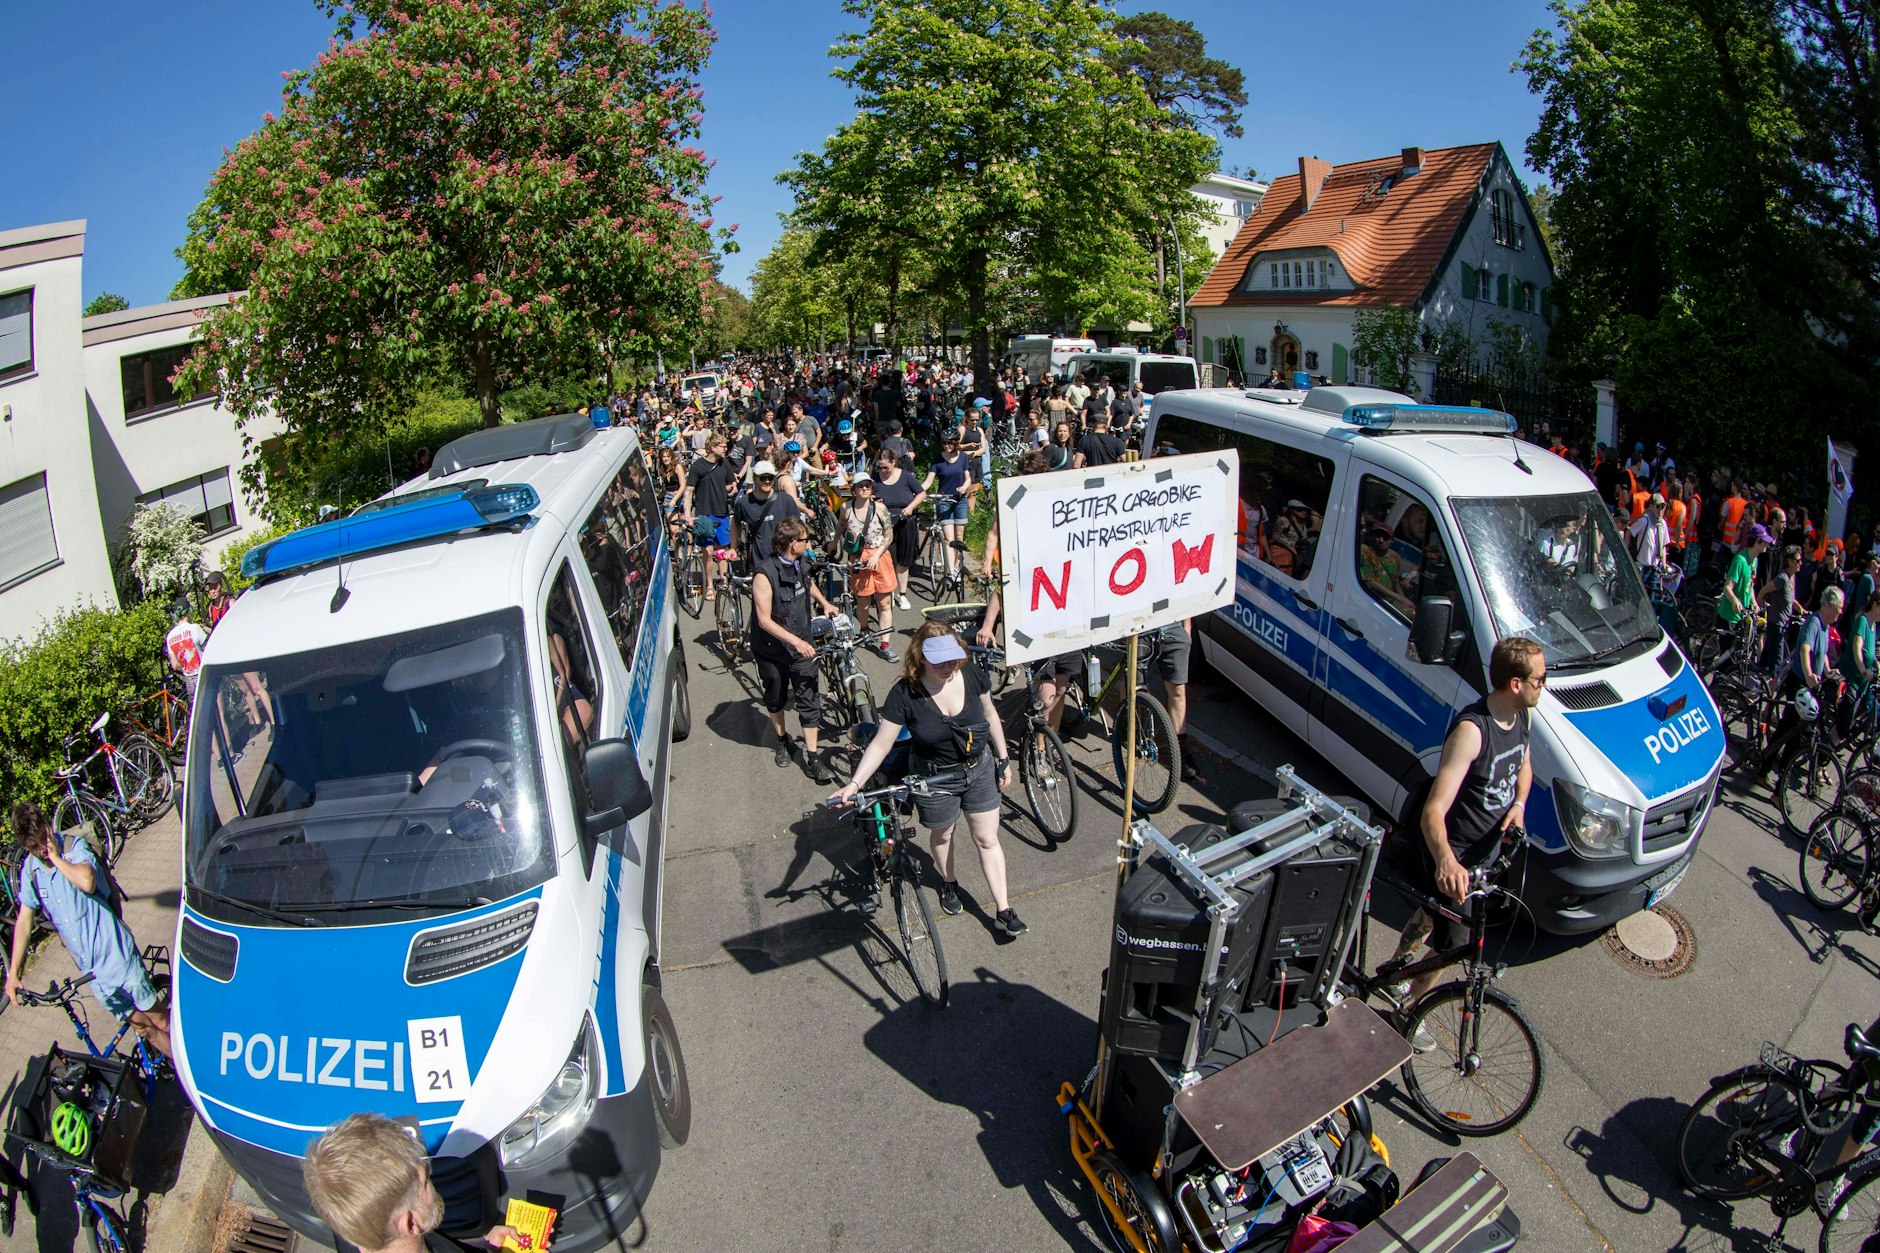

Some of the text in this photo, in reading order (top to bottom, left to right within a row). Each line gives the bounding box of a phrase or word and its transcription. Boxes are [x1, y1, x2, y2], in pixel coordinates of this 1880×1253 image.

[1052, 485, 1201, 528] BETTER CARGOBIKE
[1067, 513, 1191, 551] INFRASTRUCTURE
[1031, 534, 1214, 611] NOW
[1233, 600, 1288, 652] POLIZEI
[1643, 707, 1711, 765] POLIZEI
[1129, 936, 1230, 954] wegbassen.be
[421, 1028, 449, 1049] B1
[220, 1031, 405, 1092] POLIZEI
[427, 1069, 453, 1090] 21
